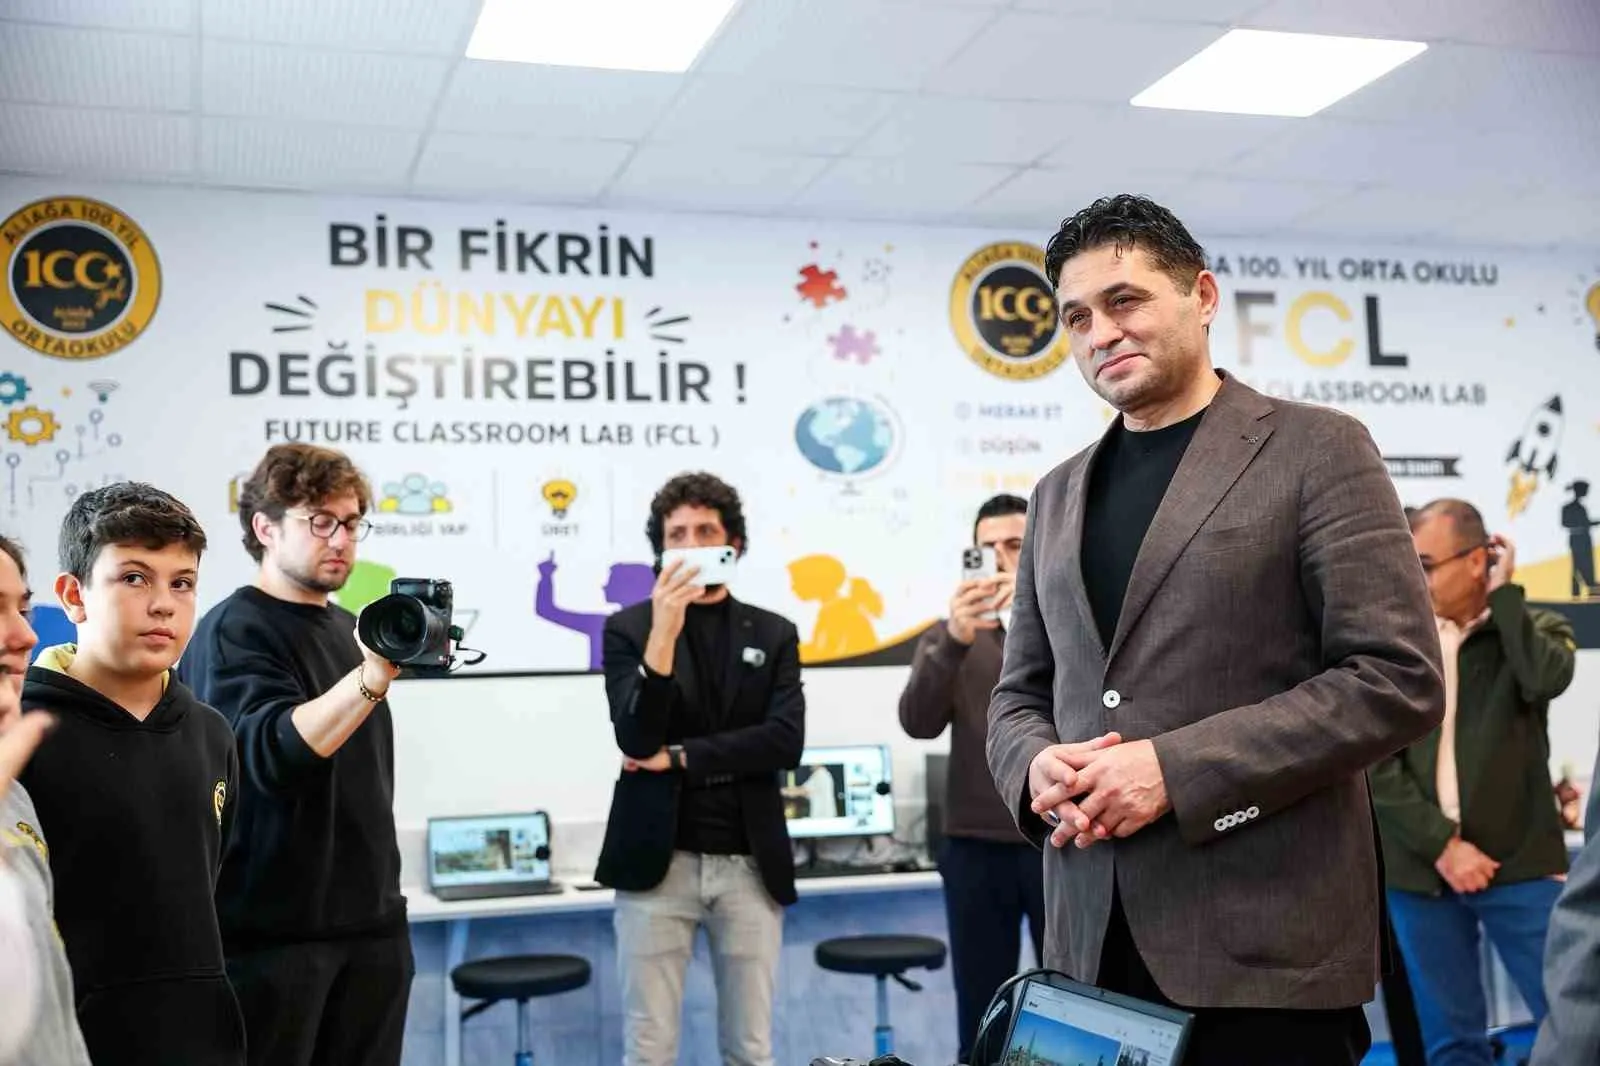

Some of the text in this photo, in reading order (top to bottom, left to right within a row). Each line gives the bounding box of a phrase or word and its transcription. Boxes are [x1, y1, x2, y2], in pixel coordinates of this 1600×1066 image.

[329, 213, 654, 278] BİR FİKRİN
[1294, 257, 1332, 280] YIL
[1337, 258, 1407, 283] ORTA
[1413, 262, 1498, 286] OKULU
[364, 279, 625, 340] DÜNYAYI
[1233, 289, 1409, 368] FCL
[12, 318, 138, 355] ORTAOKULU
[228, 341, 711, 411] DEĞİŞTİREBİLİR
[1441, 383, 1487, 406] LAB
[265, 420, 380, 443] FUTURE
[393, 421, 570, 444] CLASSROOM
[581, 424, 633, 445] LAB
